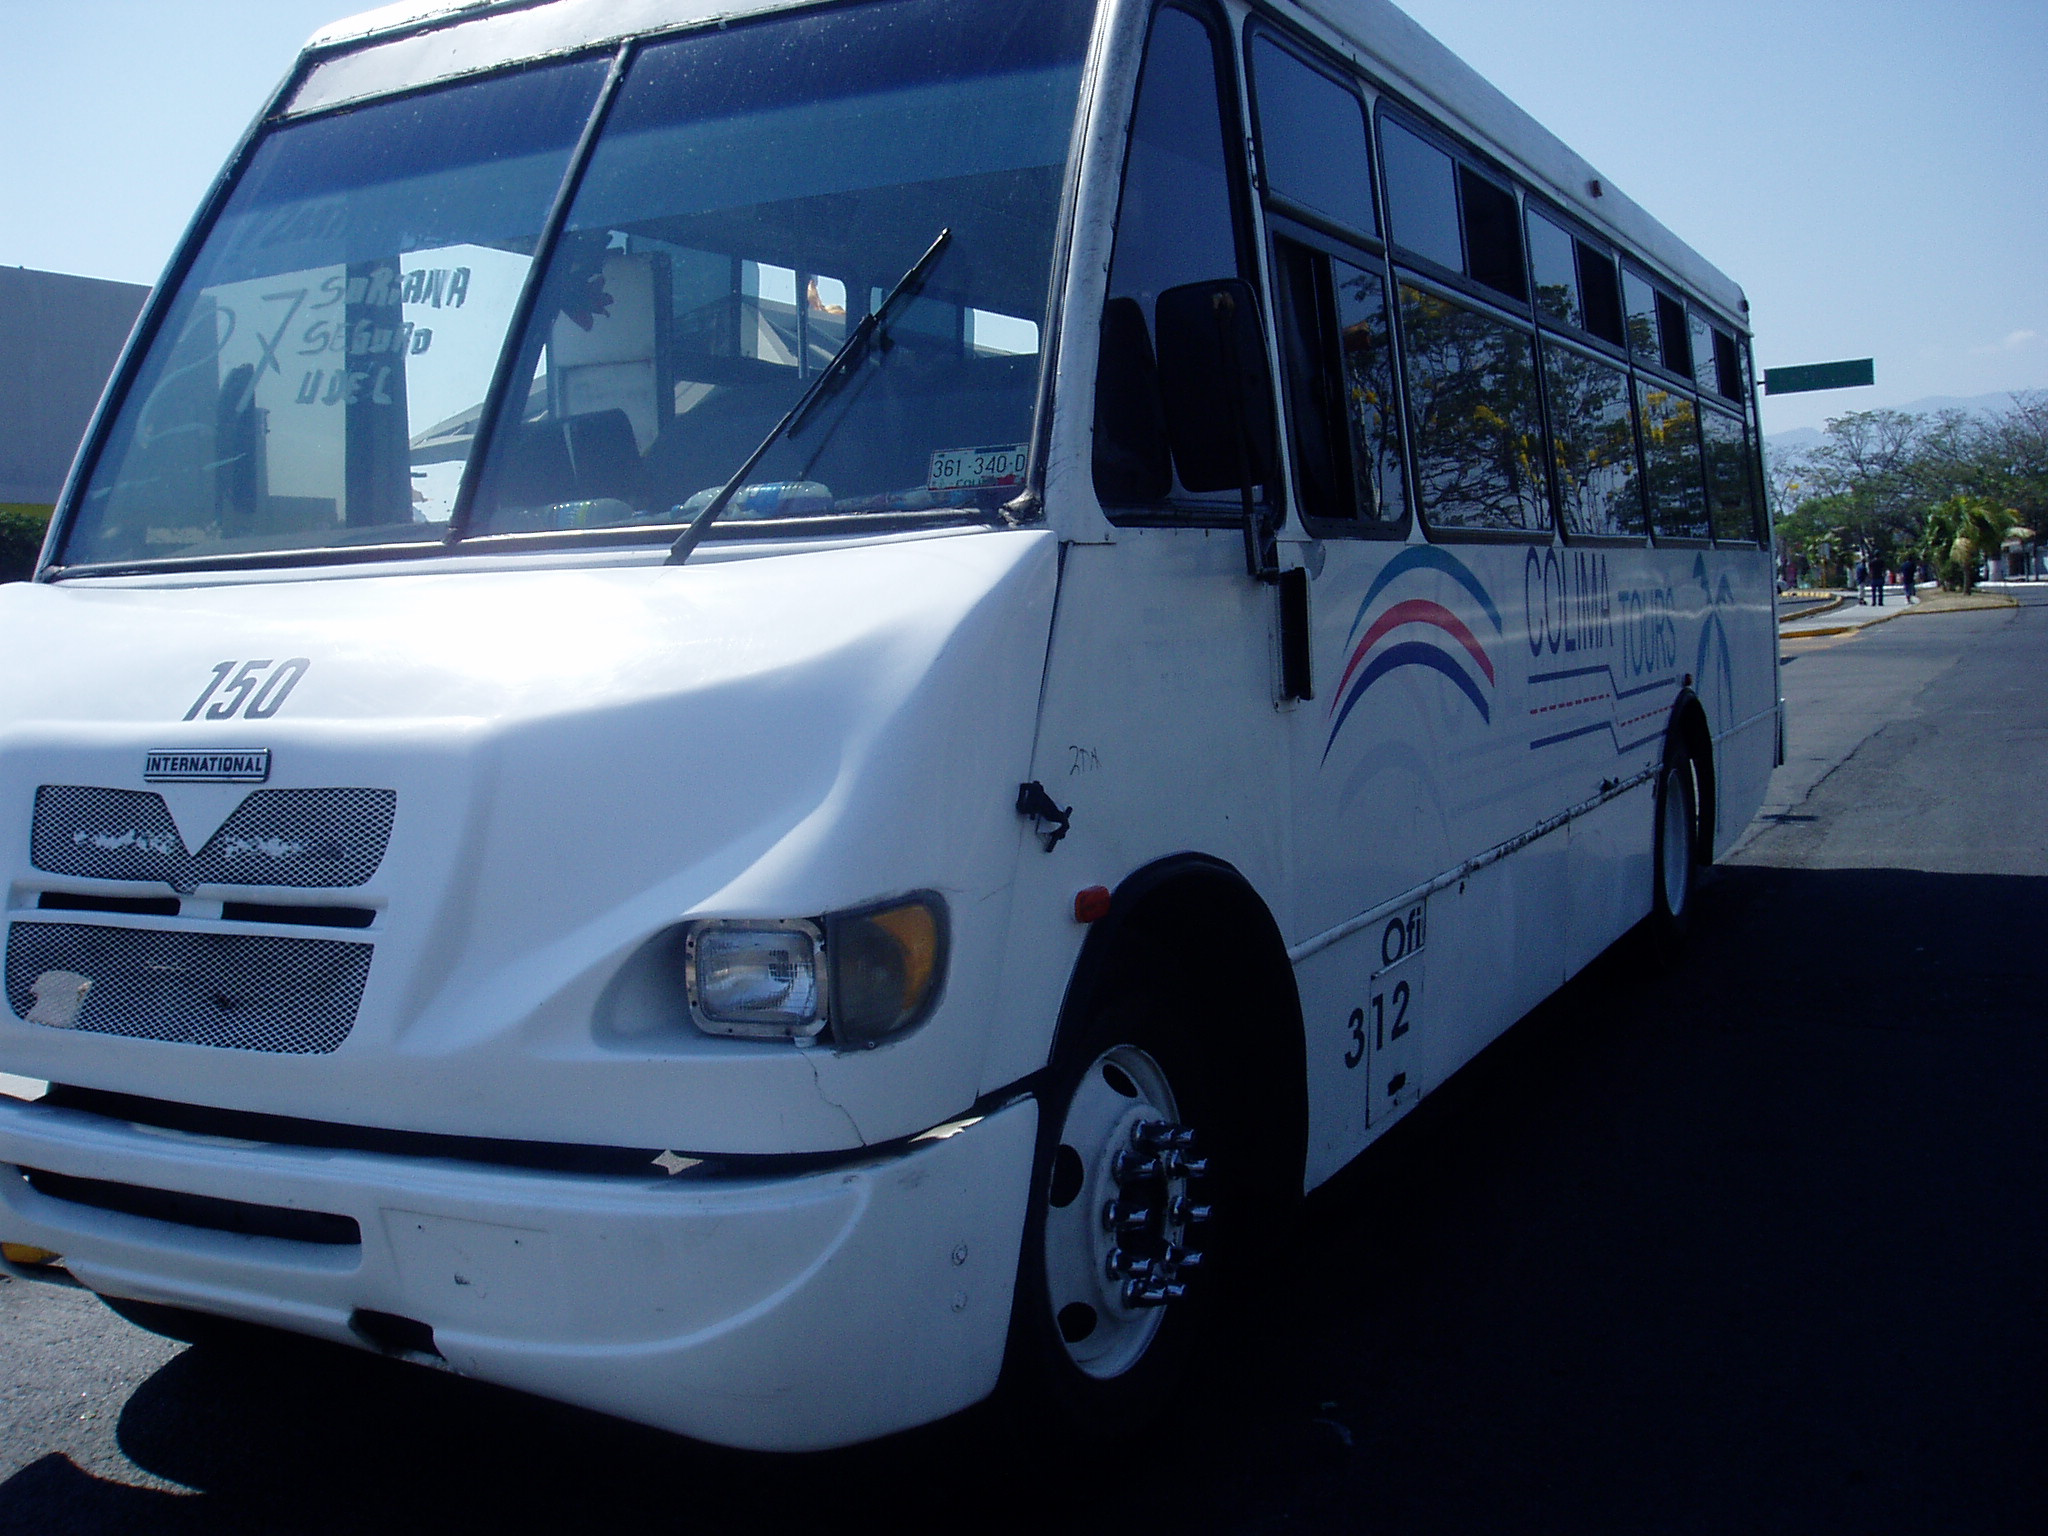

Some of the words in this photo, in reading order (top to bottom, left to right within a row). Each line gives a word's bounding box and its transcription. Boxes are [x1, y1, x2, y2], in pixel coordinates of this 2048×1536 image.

[1525, 546, 1614, 657] COLIMA
[1618, 586, 1677, 679] TOURS
[181, 657, 311, 722] 150
[145, 756, 263, 773] INTERNATIONAL
[1381, 906, 1422, 966] Ofi
[1344, 980, 1410, 1069] 312
